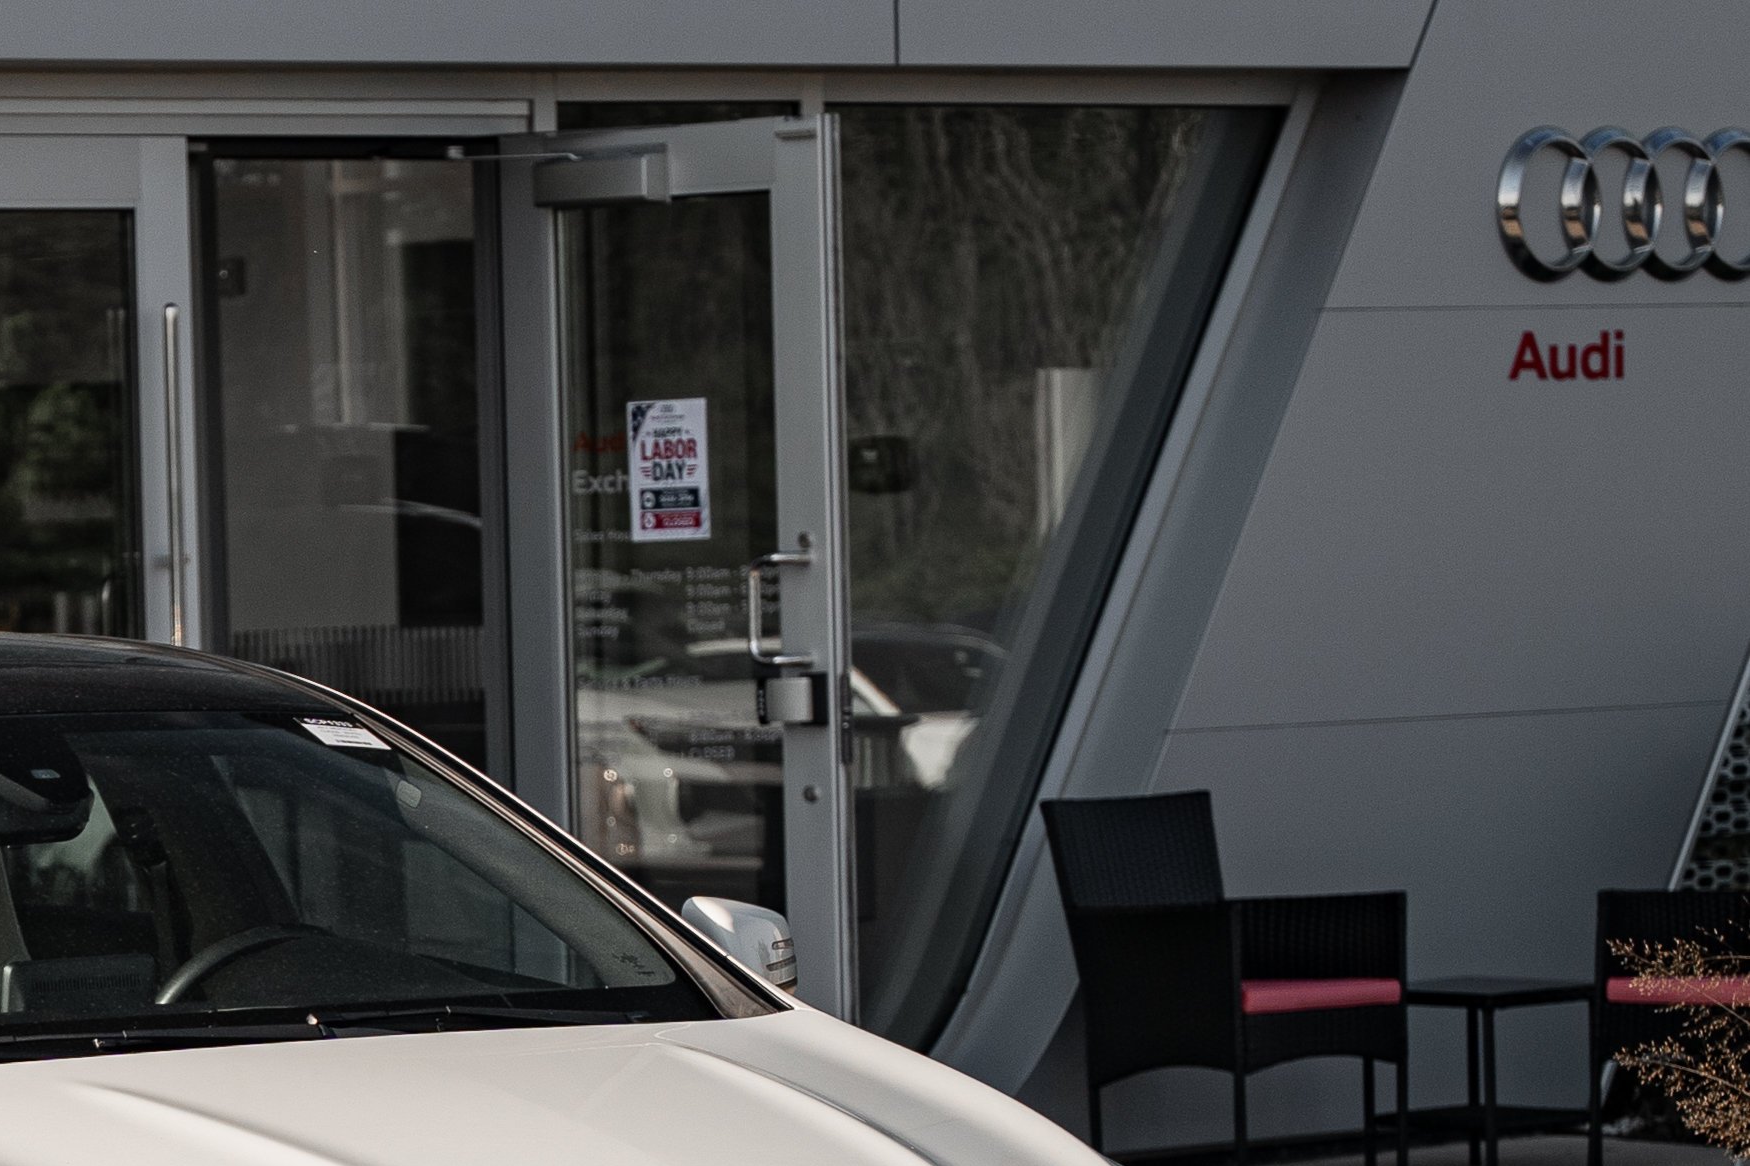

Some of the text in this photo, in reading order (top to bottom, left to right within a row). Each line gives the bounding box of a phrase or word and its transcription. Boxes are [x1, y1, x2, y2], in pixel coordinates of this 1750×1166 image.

[1508, 330, 1625, 381] Audi
[640, 438, 697, 461] LABOR
[573, 469, 628, 495] Exch
[652, 460, 686, 481] DAY
